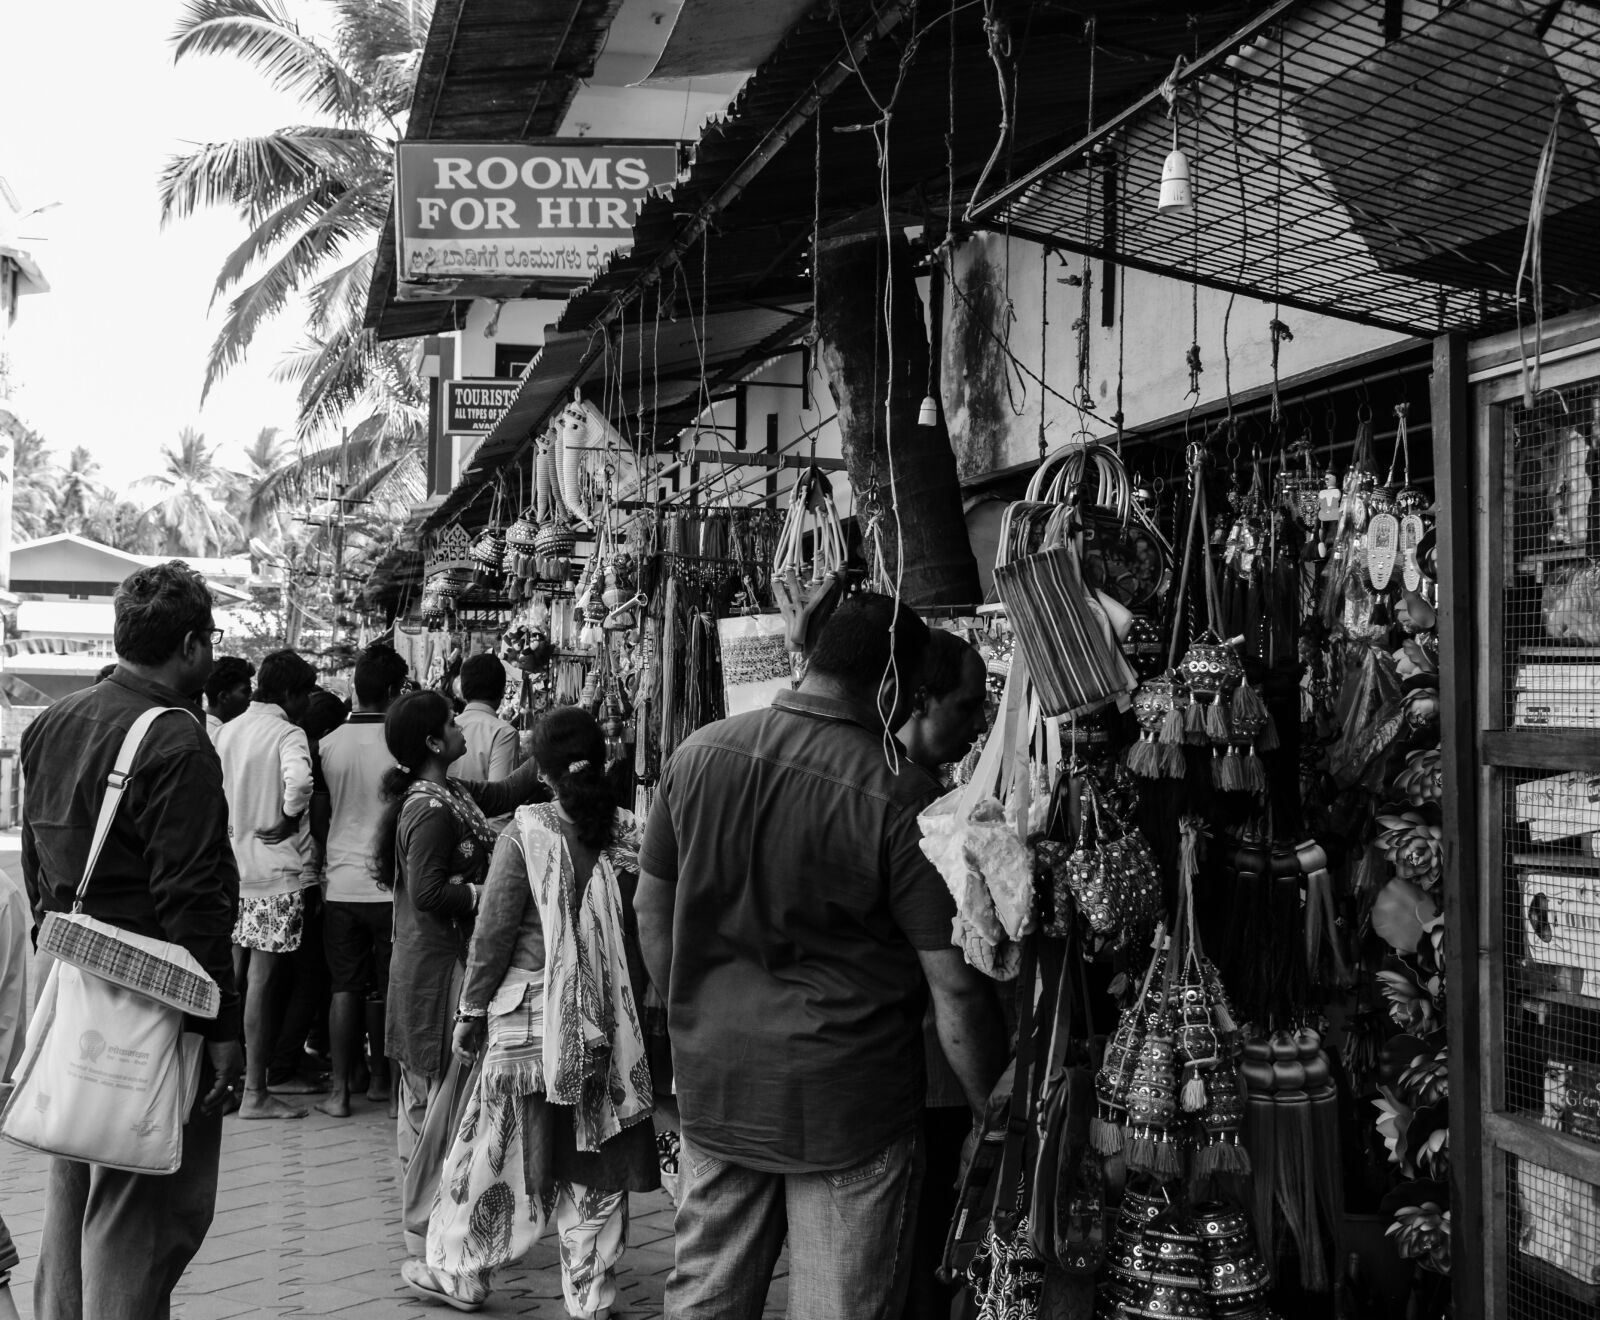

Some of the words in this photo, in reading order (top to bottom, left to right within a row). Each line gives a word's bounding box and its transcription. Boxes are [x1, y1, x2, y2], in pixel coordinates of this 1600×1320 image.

[433, 157, 649, 190] ROOMS
[417, 197, 520, 230] FOR
[455, 408, 466, 419] ALL
[468, 408, 487, 420] TYPES
[488, 408, 497, 420] OF
